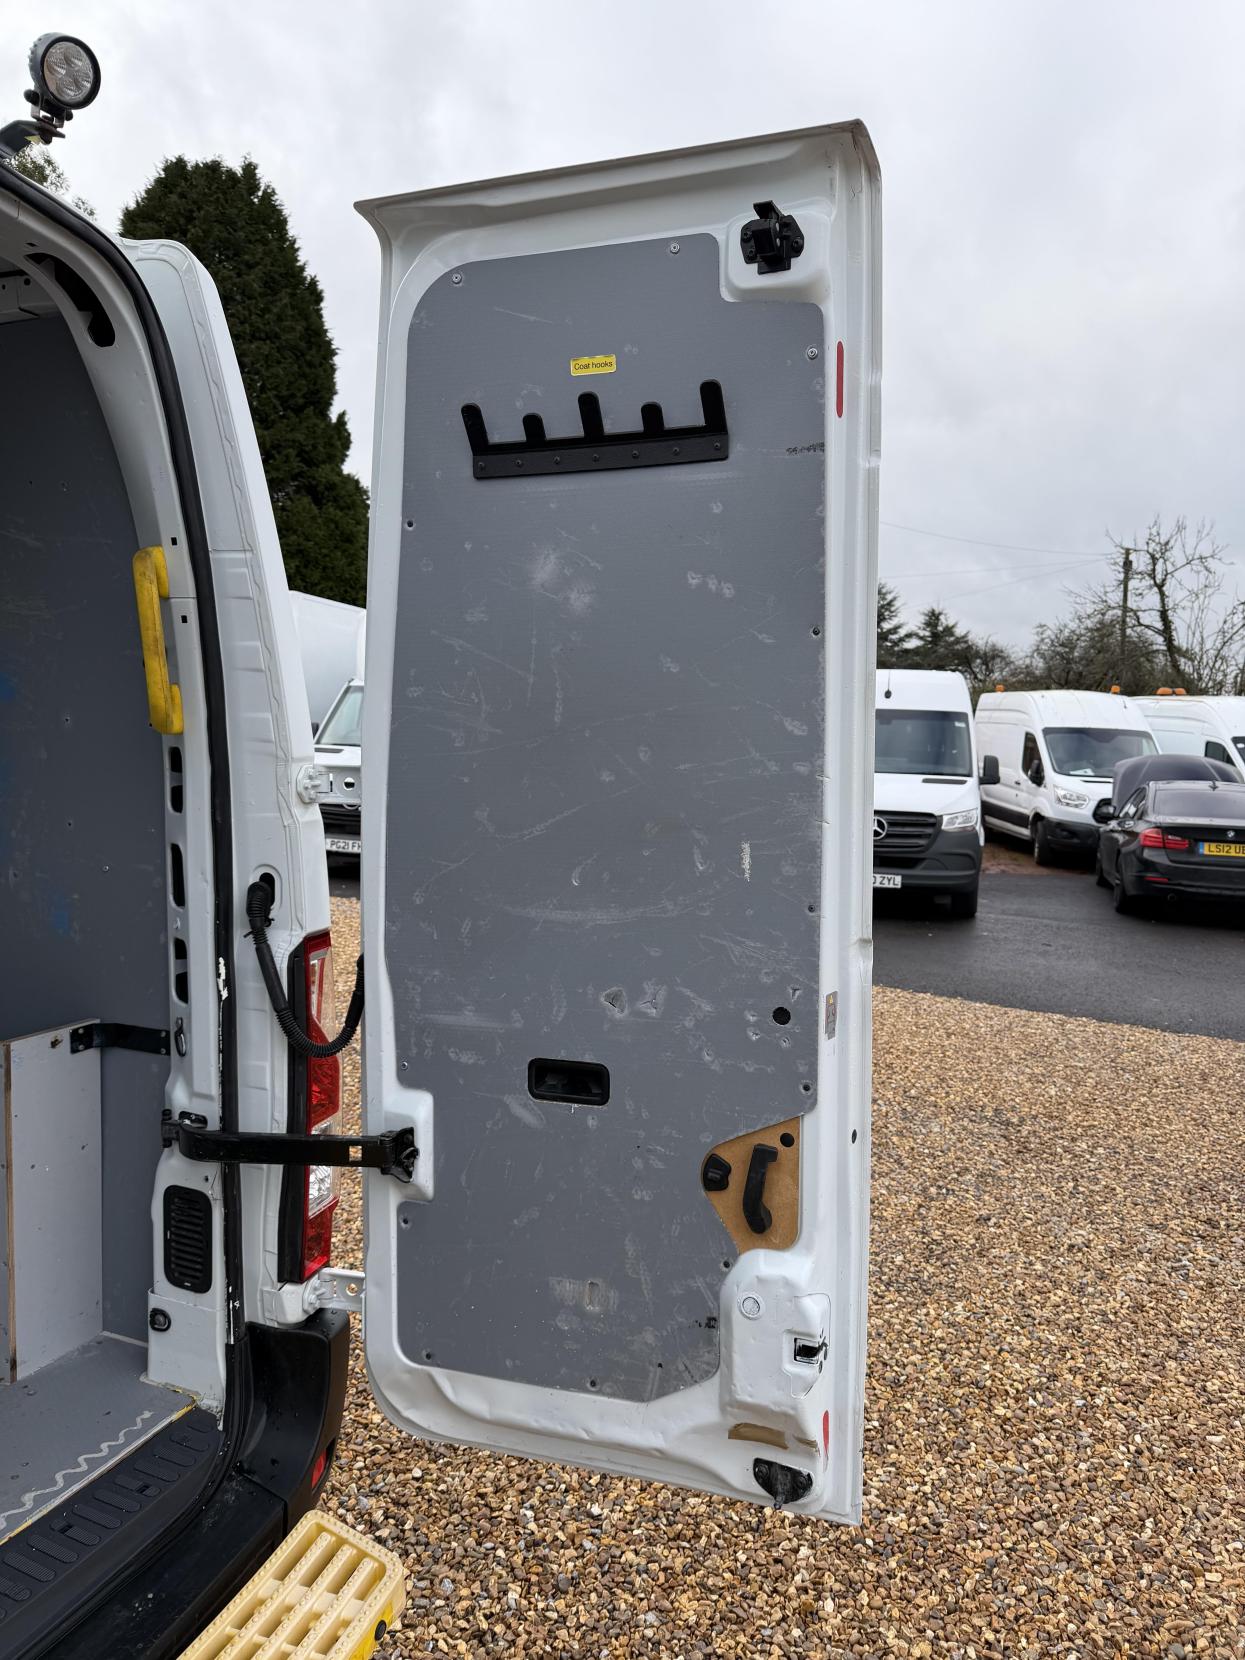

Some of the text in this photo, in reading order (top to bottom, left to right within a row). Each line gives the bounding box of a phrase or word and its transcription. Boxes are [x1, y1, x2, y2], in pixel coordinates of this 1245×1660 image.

[574, 360, 613, 371] Coat hooks
[330, 839, 350, 850] PG21
[1208, 843, 1232, 854] LS12
[879, 875, 900, 886] ZYL
